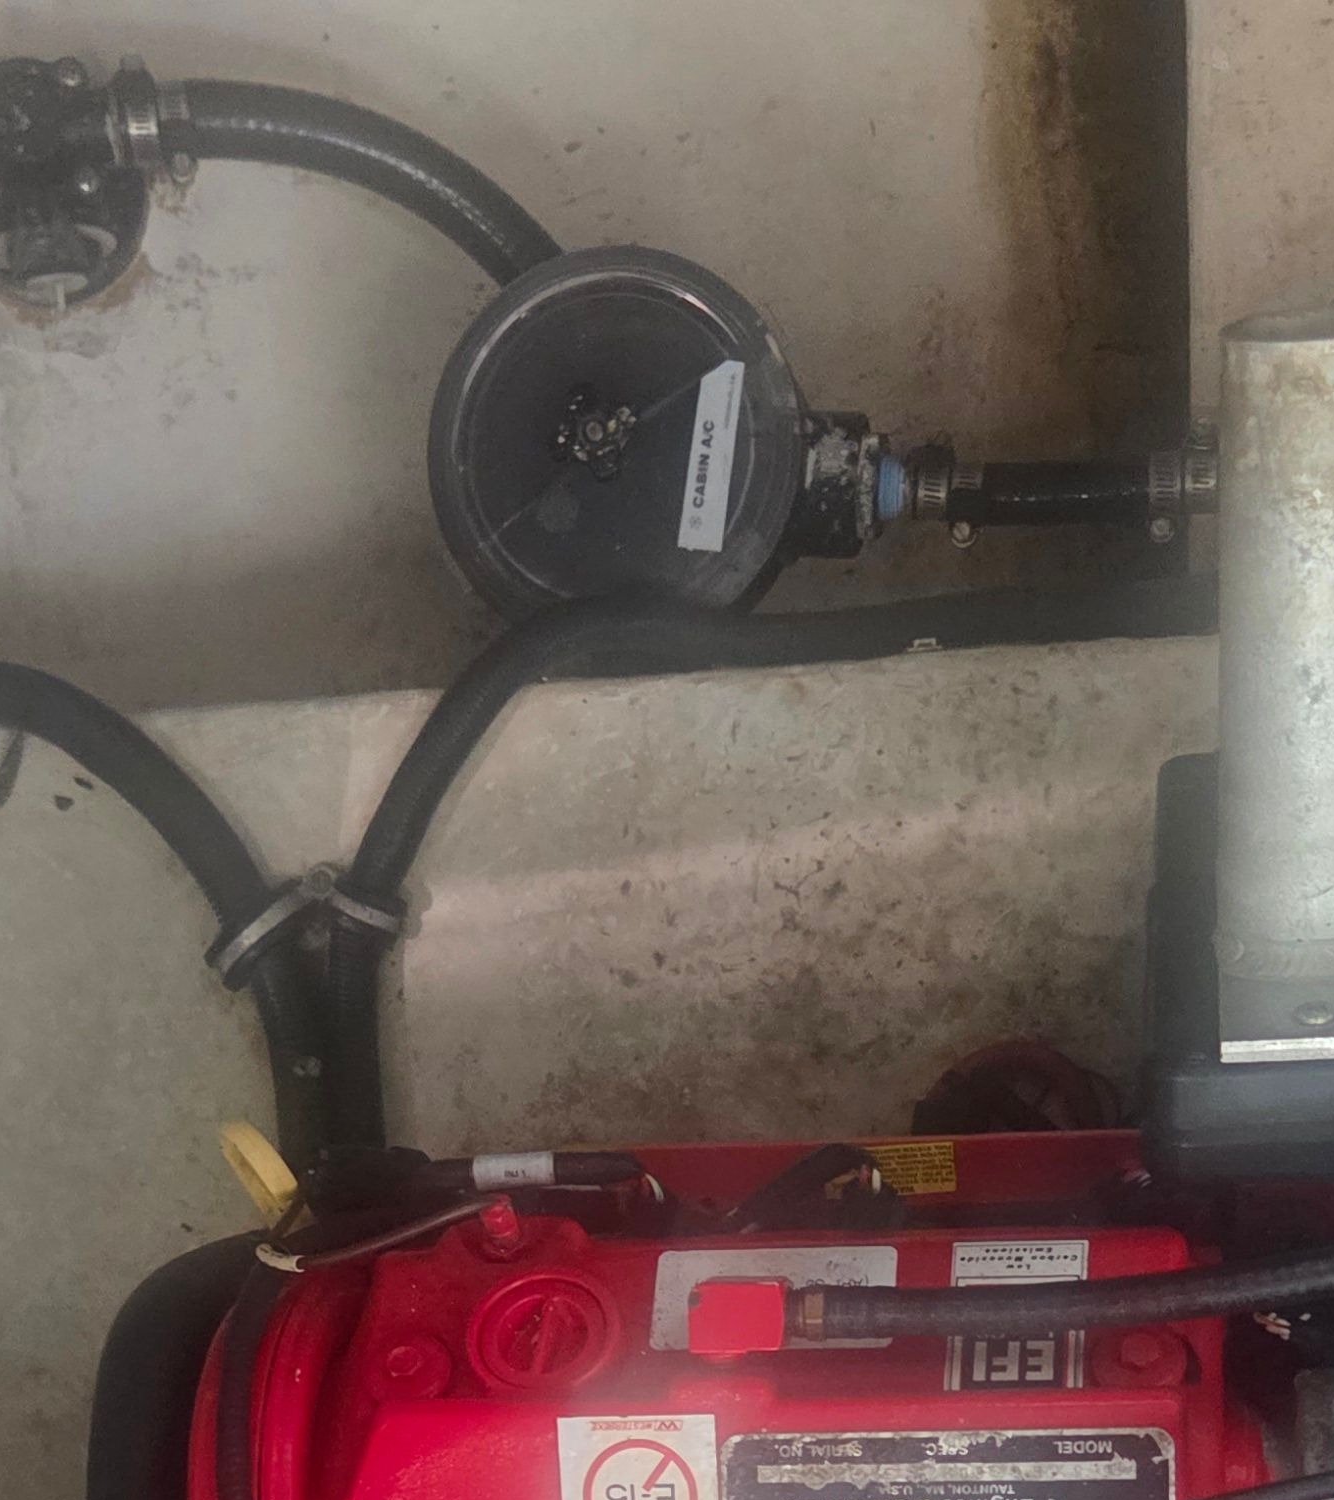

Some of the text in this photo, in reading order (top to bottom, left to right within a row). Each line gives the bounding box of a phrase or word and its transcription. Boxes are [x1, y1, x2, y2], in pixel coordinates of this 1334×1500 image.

[692, 420, 714, 508] CABIN A/C
[972, 1340, 1055, 1382] EFI
[774, 1440, 1112, 1457] MODEL SPEC. SERIAL NO.
